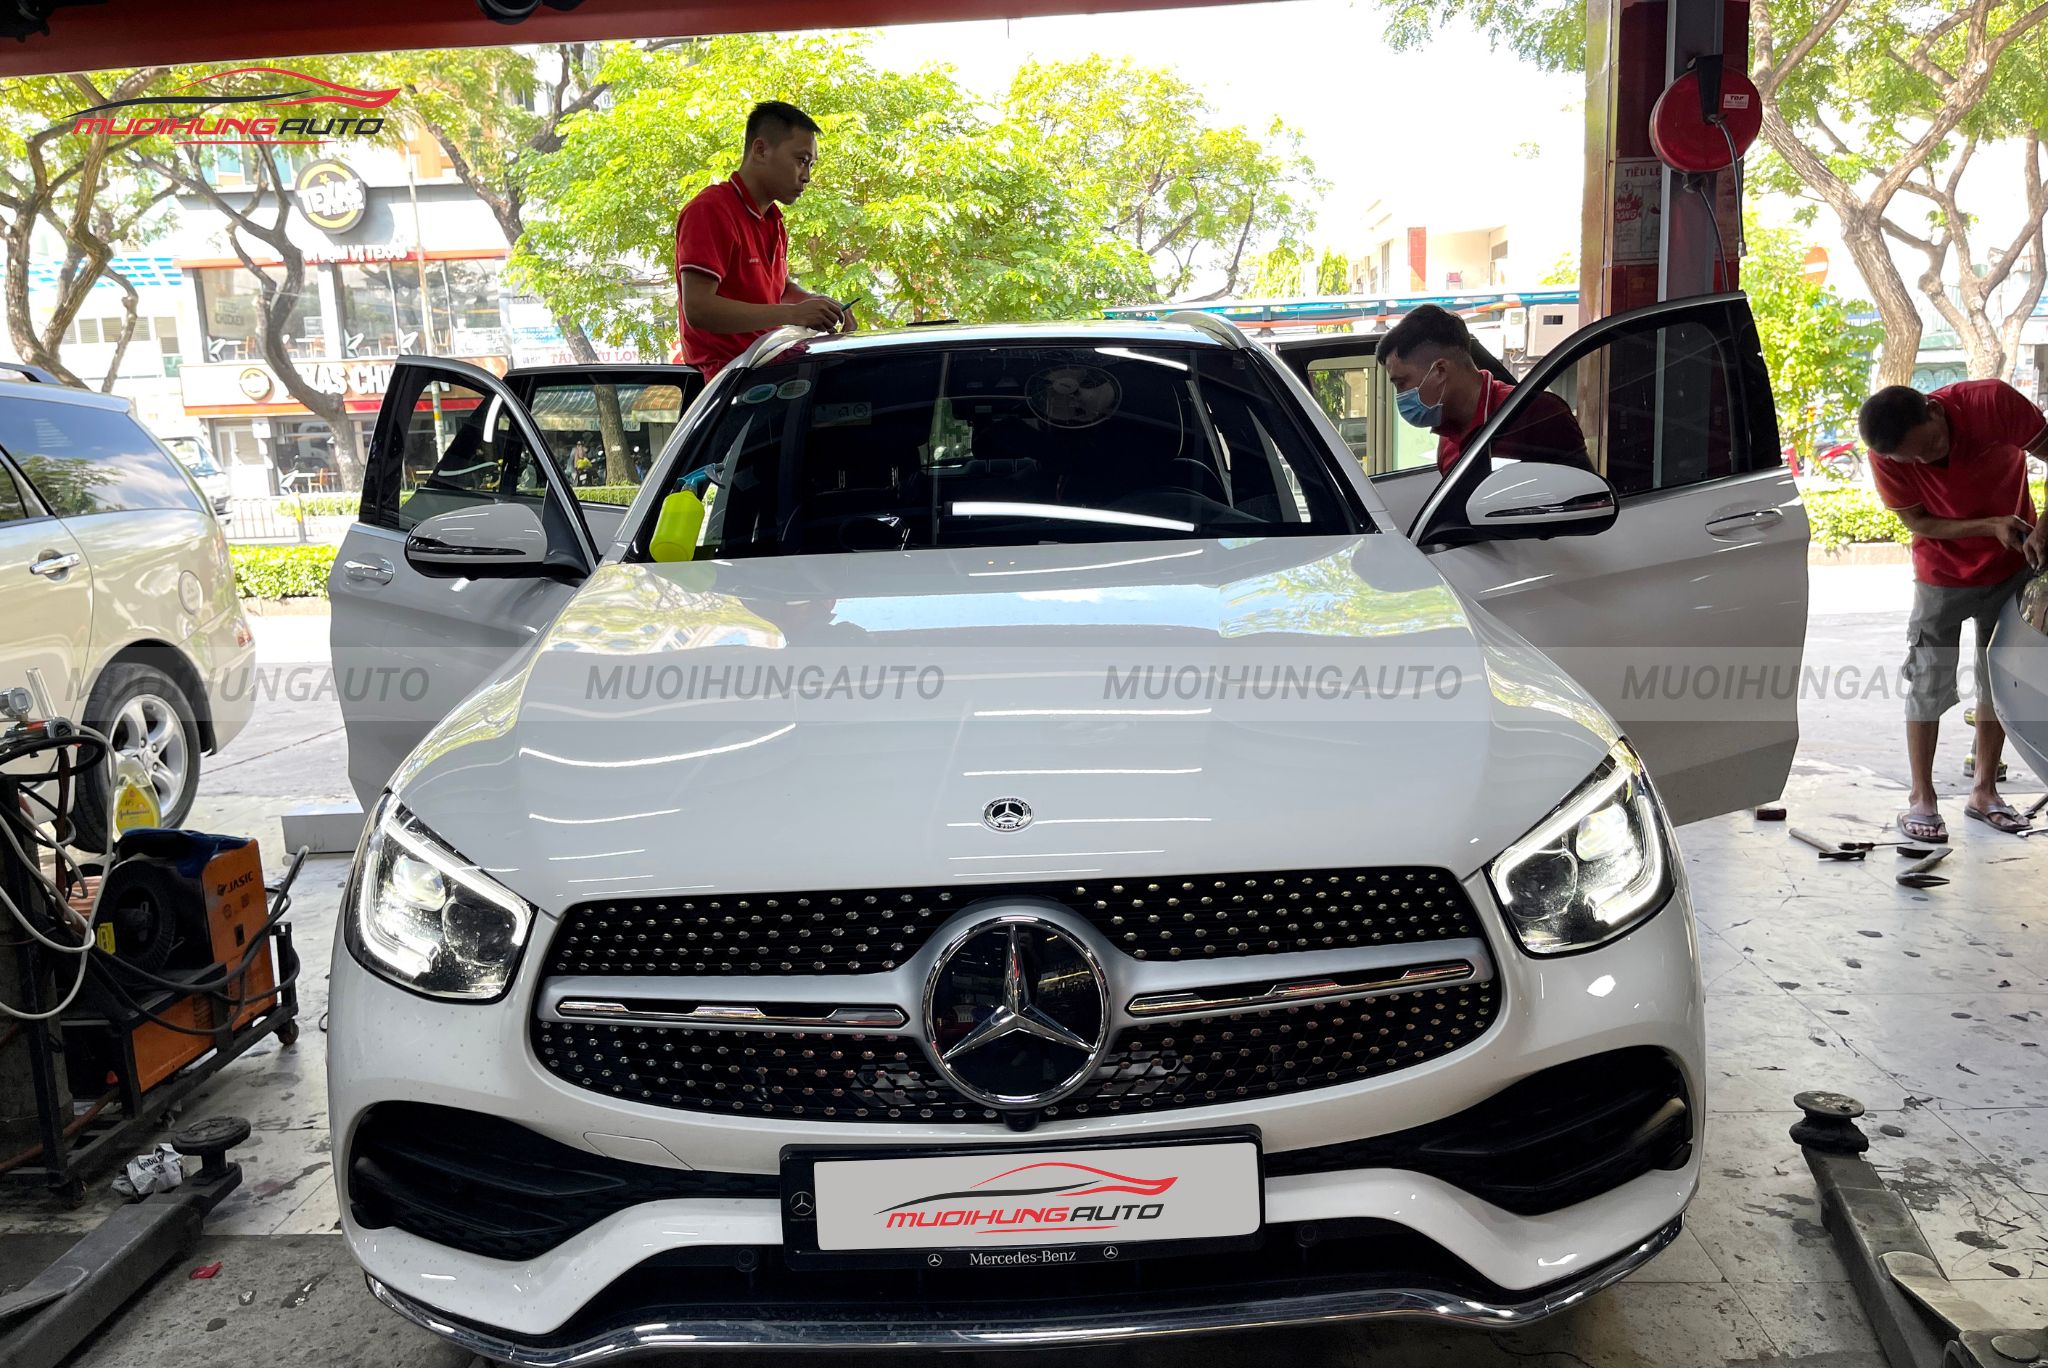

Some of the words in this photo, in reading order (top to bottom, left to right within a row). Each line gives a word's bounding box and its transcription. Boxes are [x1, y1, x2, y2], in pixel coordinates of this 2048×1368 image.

[296, 178, 364, 215] TEXAS
[615, 349, 640, 364] LON
[228, 870, 254, 893] JASIC
[969, 1250, 1077, 1266] Mercedes-Benz
